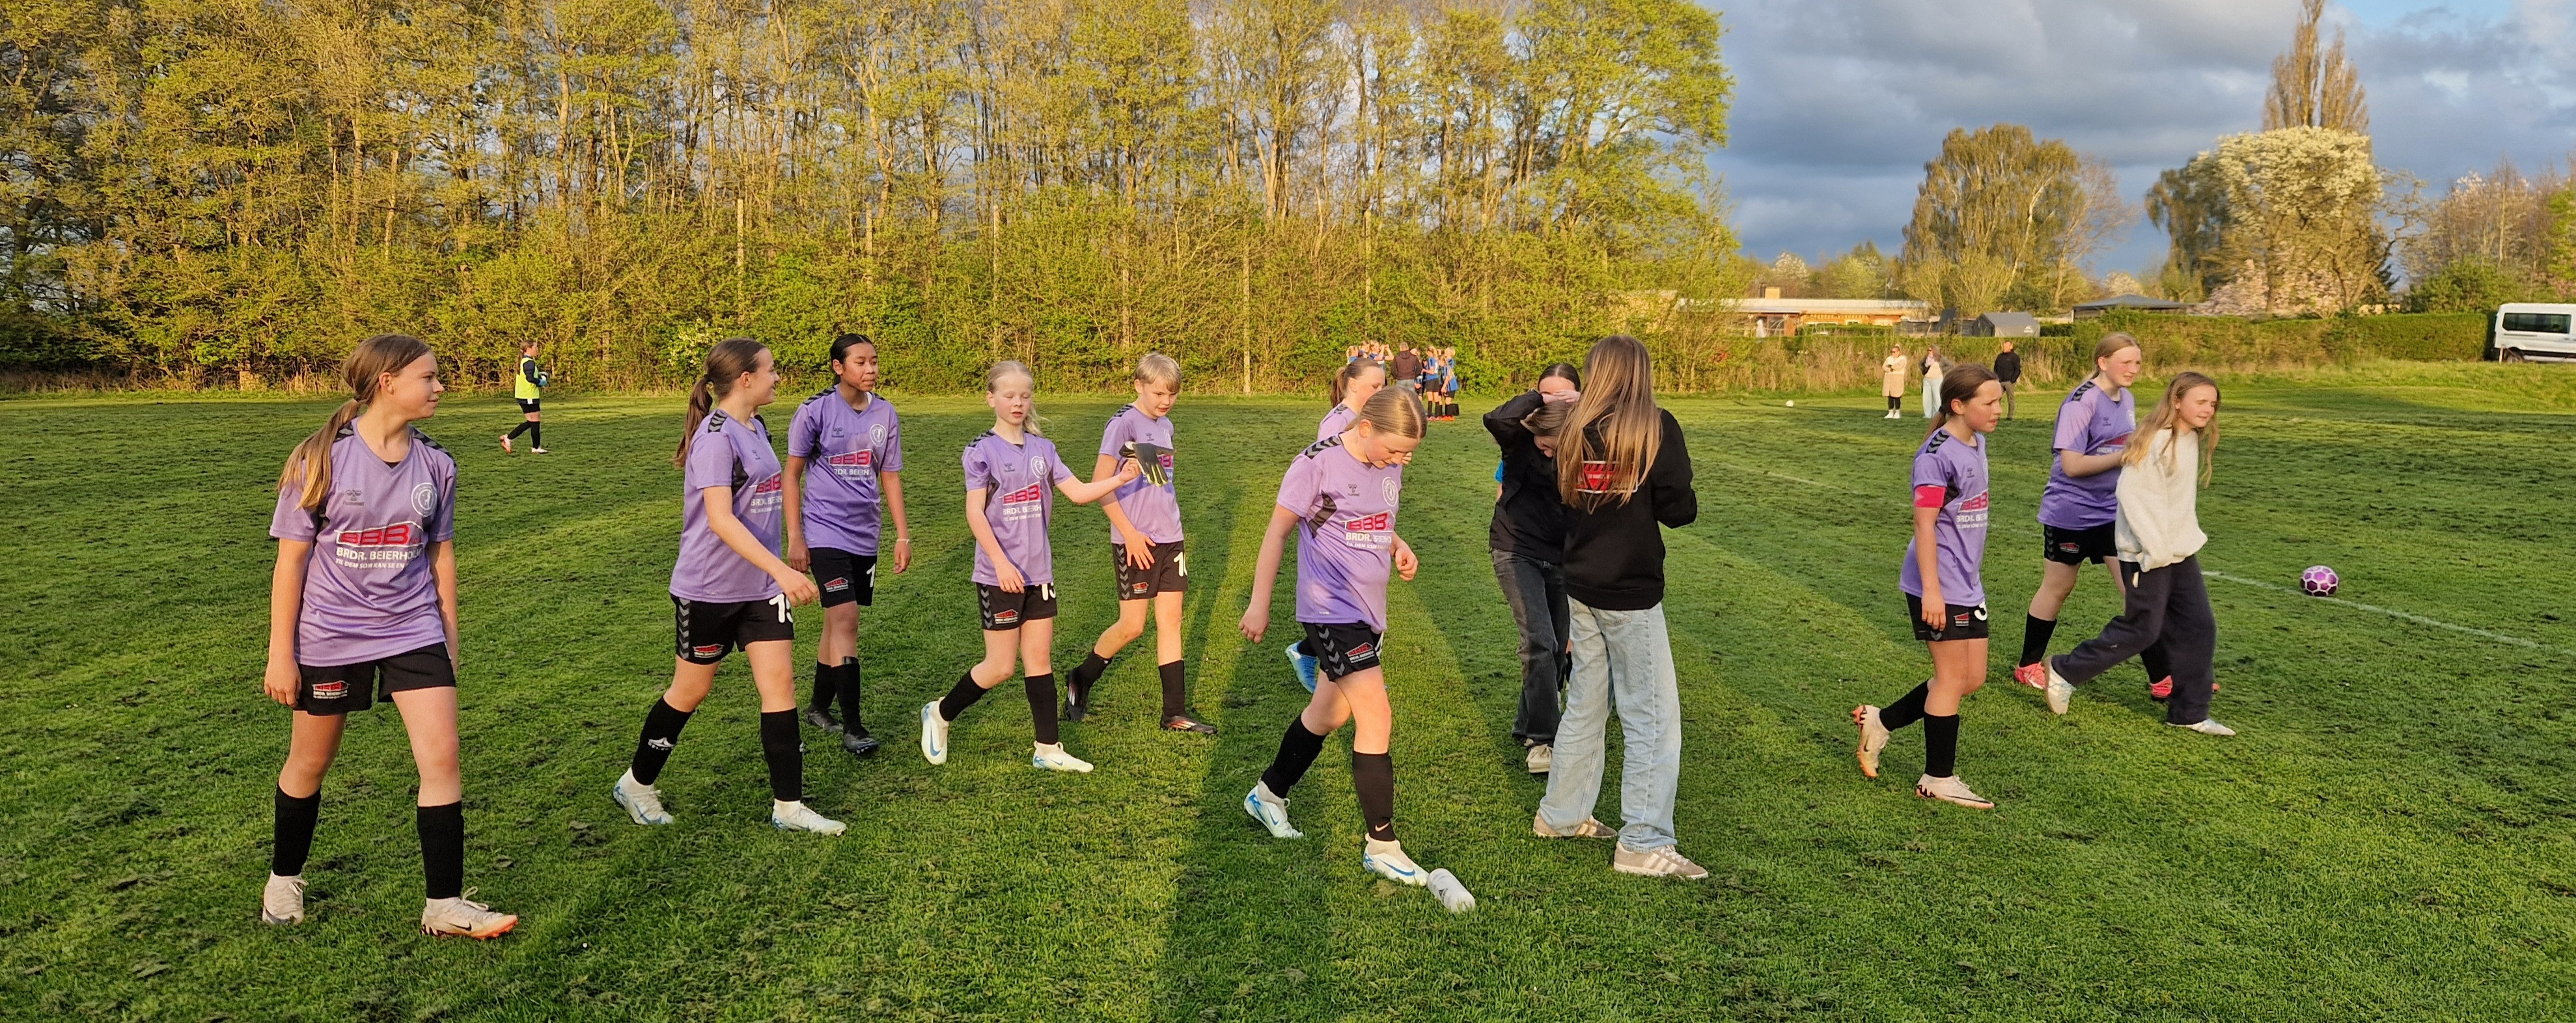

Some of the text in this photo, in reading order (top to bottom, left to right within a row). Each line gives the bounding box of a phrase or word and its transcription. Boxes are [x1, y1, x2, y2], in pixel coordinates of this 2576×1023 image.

[831, 450, 871, 465] BBB
[1348, 513, 1387, 530] BBB
[341, 524, 410, 545] BBB
[1346, 532, 1372, 541] BRDR.
[336, 547, 367, 560] BRDR.
